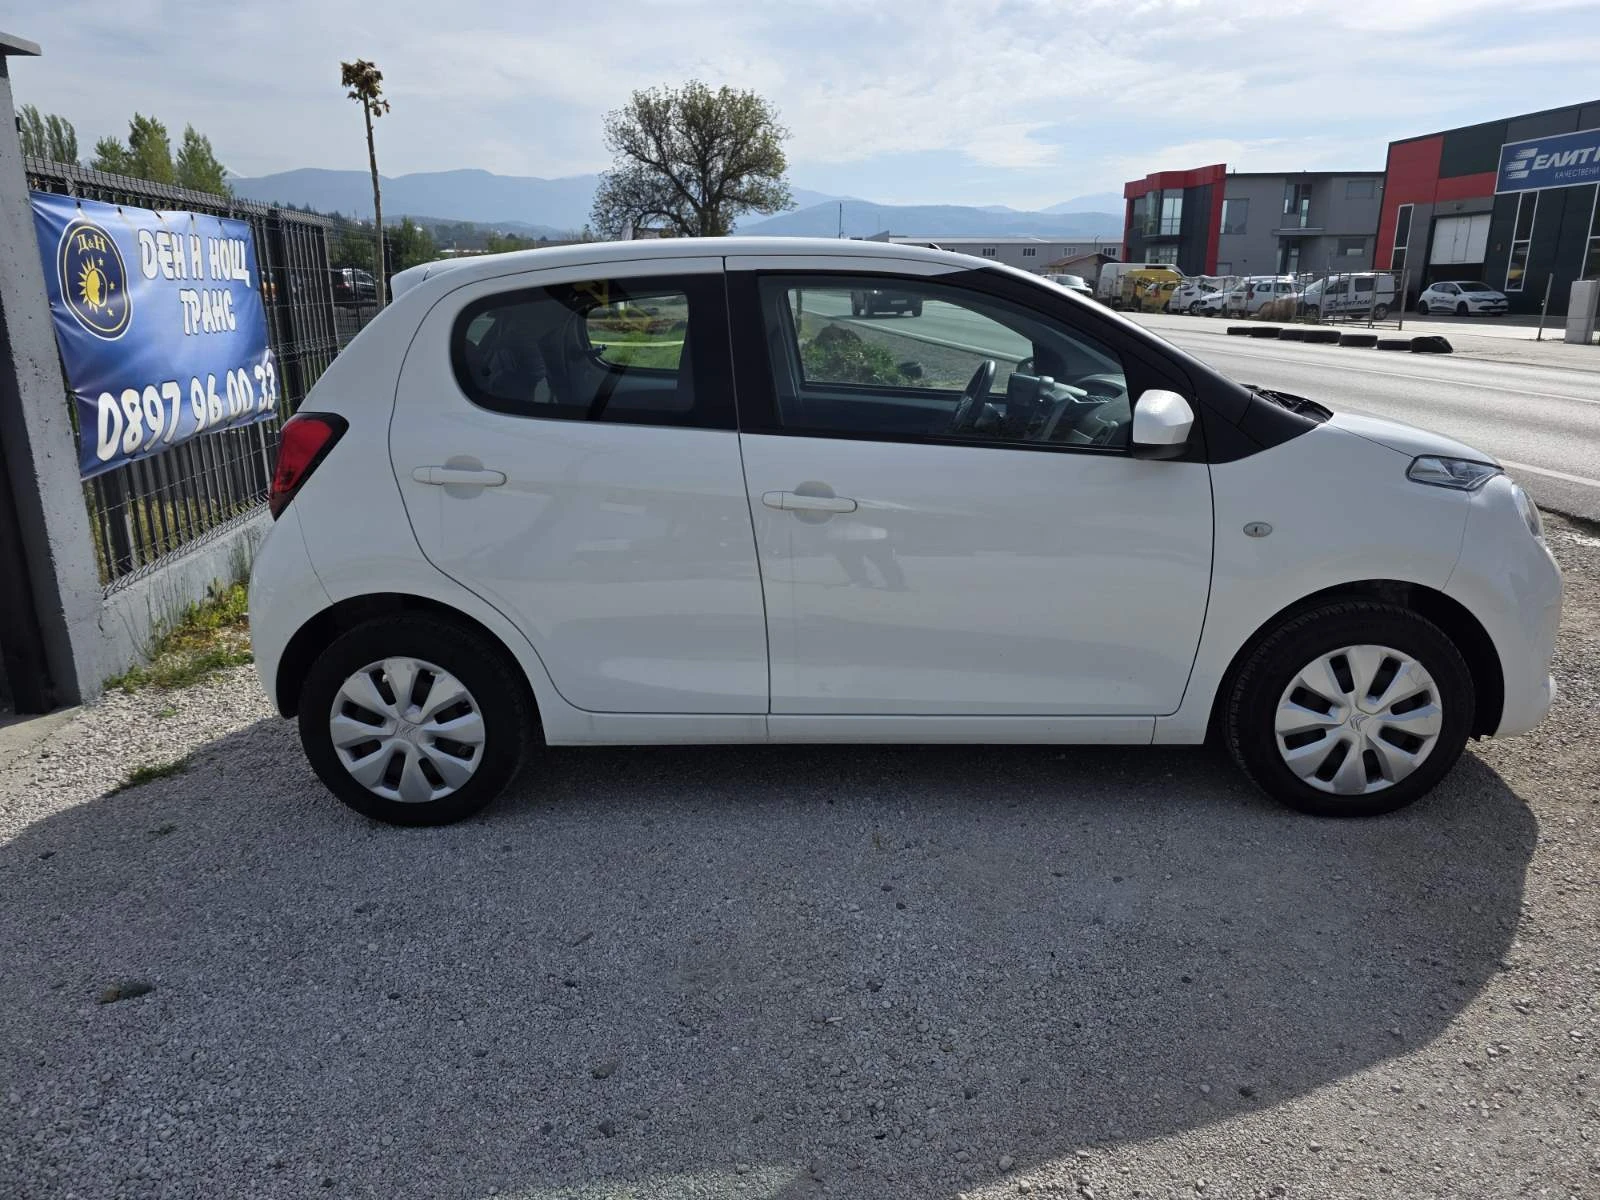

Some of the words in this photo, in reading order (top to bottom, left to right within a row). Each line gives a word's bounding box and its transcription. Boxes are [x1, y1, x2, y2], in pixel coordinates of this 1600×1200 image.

[138, 229, 188, 280] ДЕН
[207, 236, 251, 288] НОЩ
[179, 288, 236, 336] ТРАНС
[96, 380, 181, 462] 0897
[190, 375, 223, 434] 96
[226, 367, 254, 416] 00
